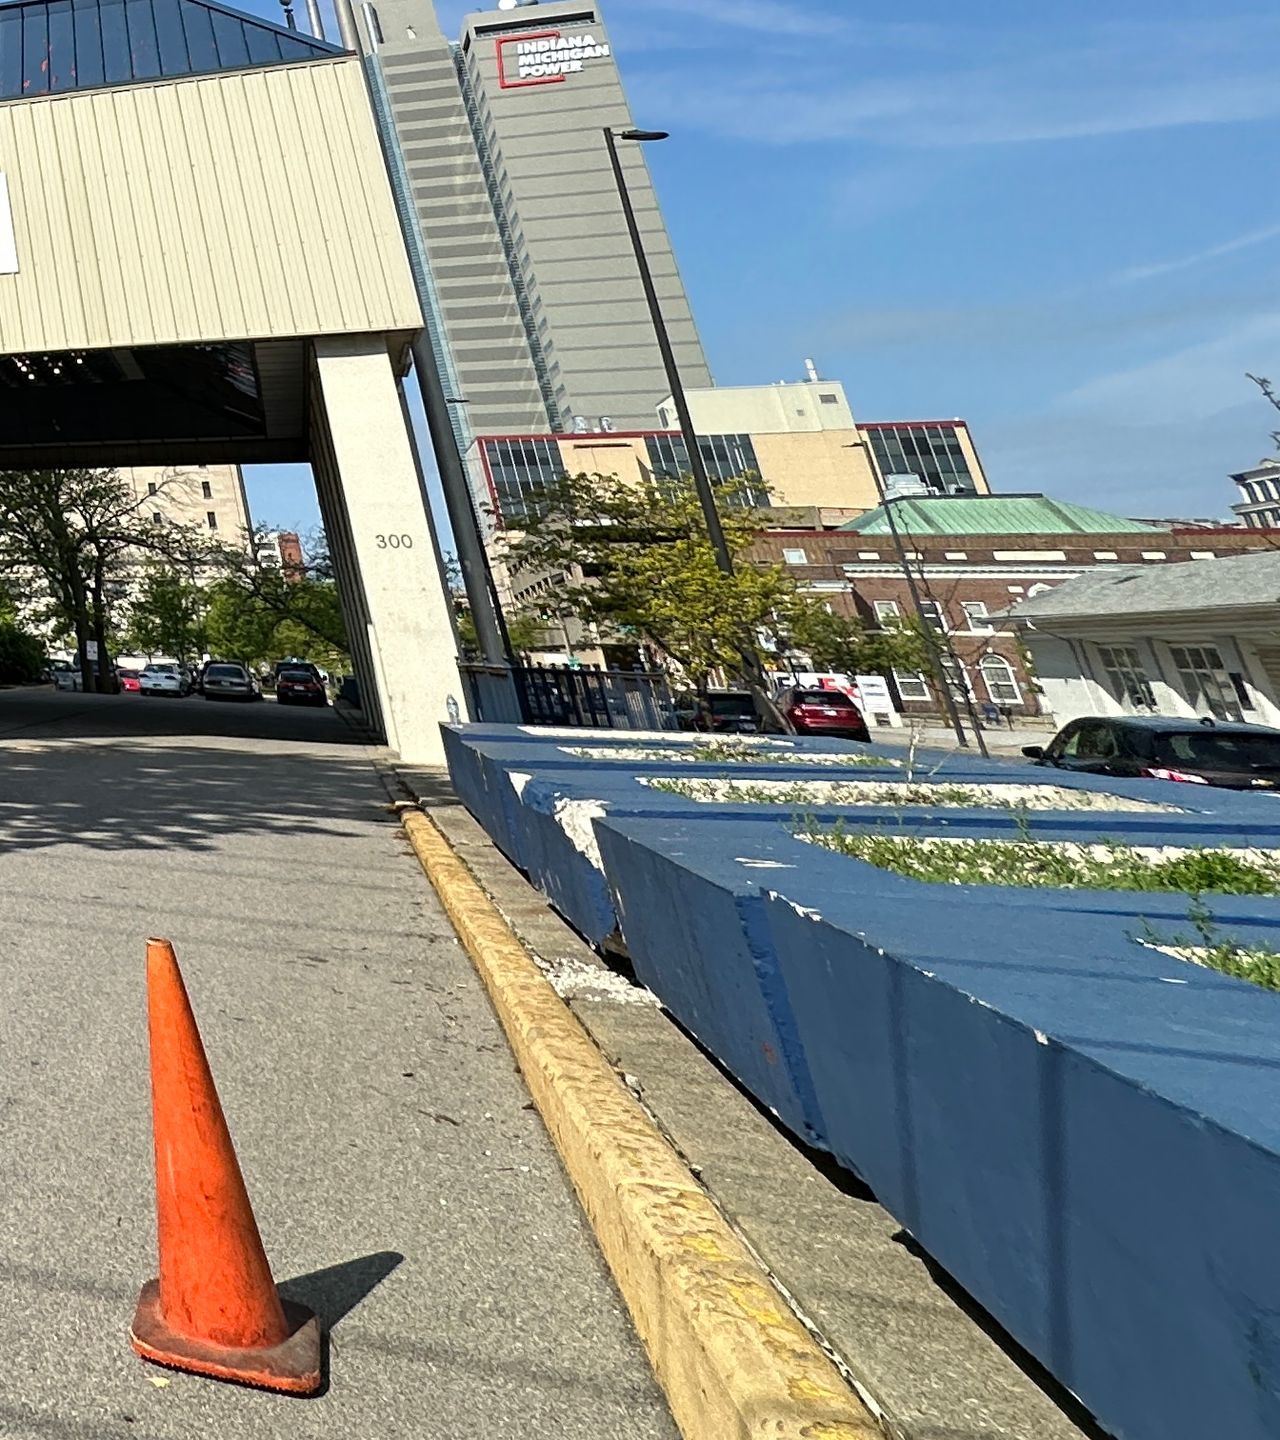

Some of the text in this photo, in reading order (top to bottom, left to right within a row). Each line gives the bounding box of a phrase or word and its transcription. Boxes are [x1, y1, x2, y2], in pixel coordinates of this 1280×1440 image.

[517, 35, 596, 54] INDIANA
[518, 44, 610, 66] MICHIGAN
[519, 60, 584, 78] POWER
[375, 534, 413, 549] 300
